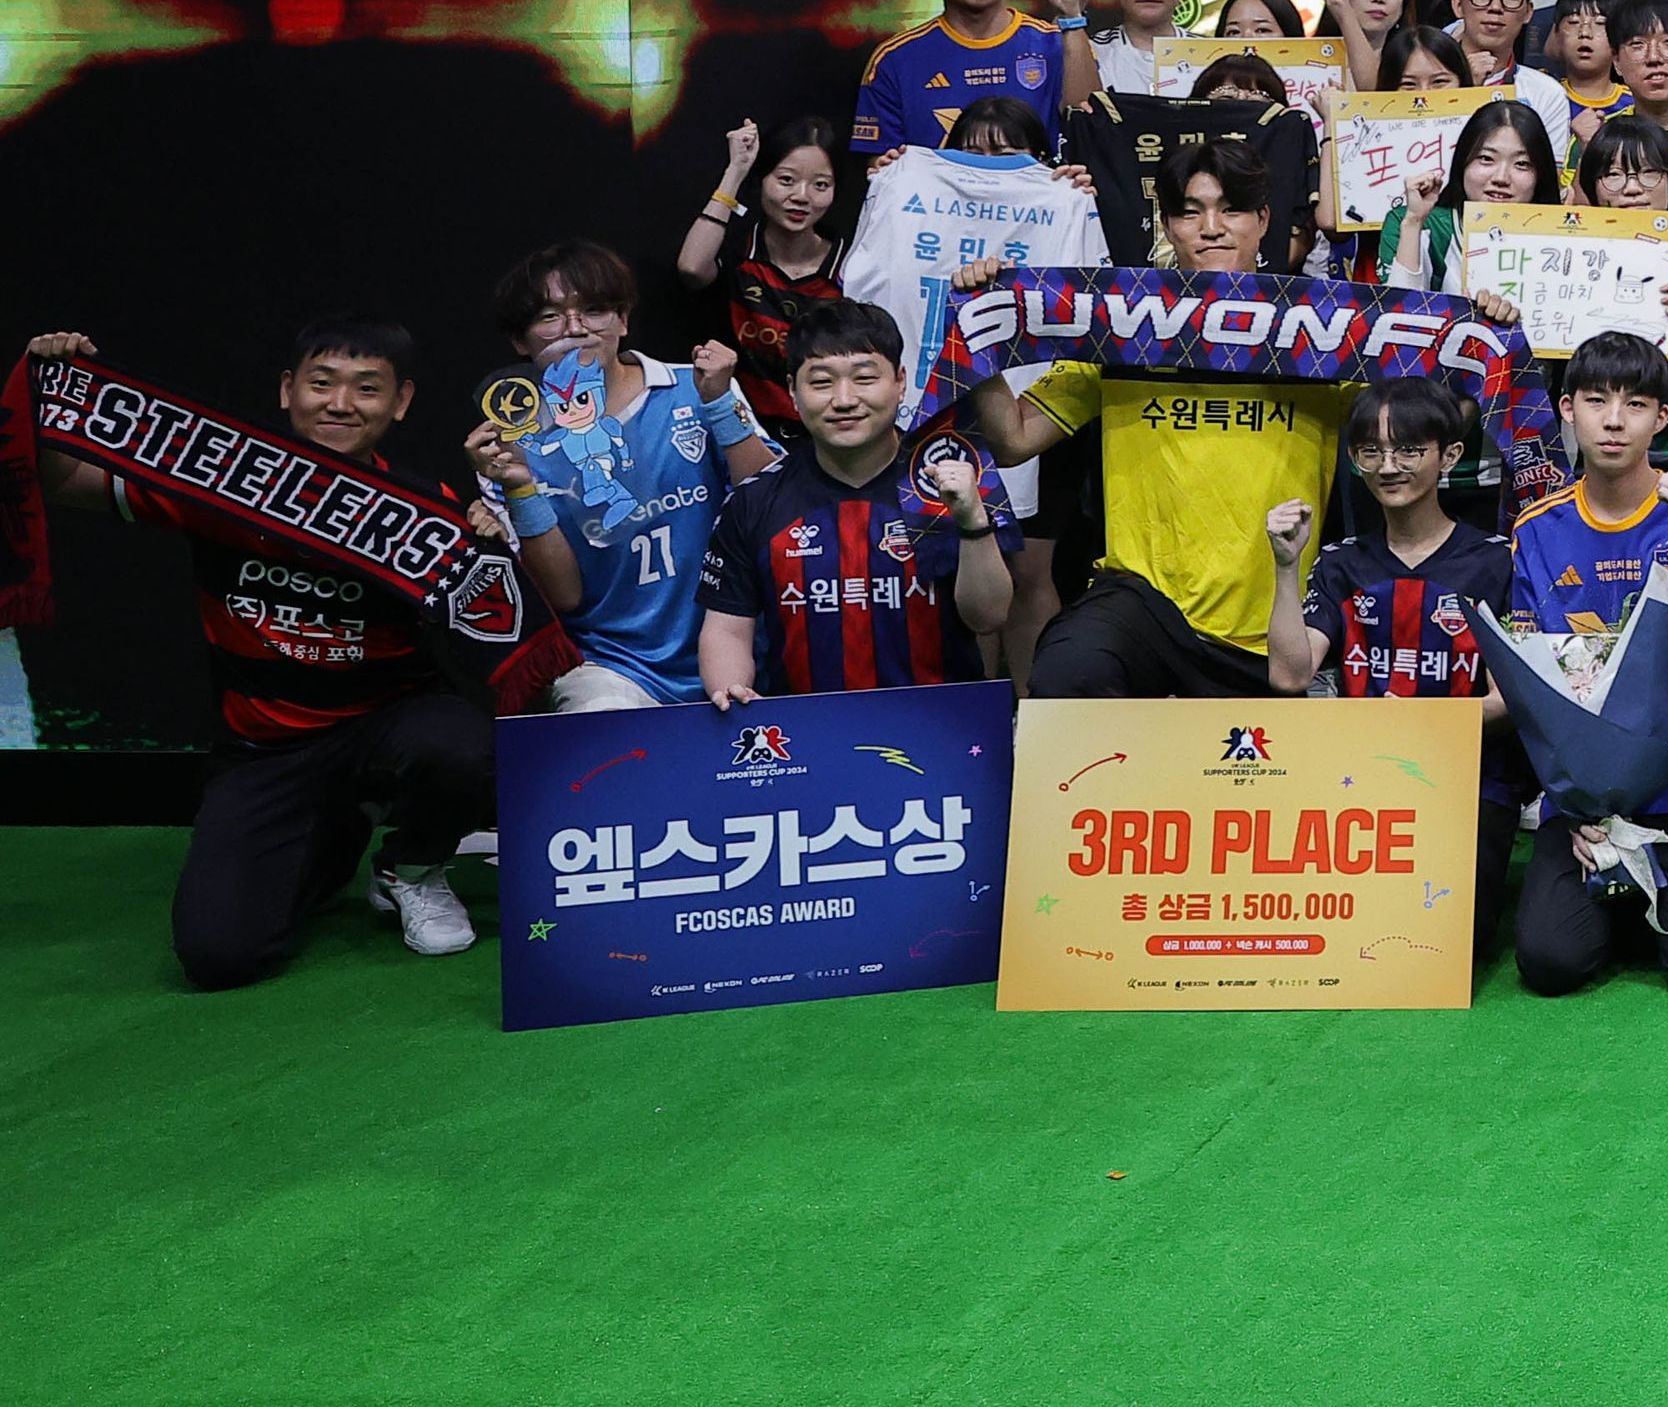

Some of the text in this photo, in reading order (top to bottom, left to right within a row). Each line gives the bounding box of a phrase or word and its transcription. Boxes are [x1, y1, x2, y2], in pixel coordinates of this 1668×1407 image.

[933, 198, 1057, 227] LASHEVAN
[956, 289, 1510, 383] SUWON FC
[1140, 397, 1296, 432] 수원특례시
[84, 382, 462, 580] STEELERS
[630, 524, 678, 588] 27
[238, 559, 365, 603] posco
[779, 576, 937, 616] 수원특례시
[1343, 644, 1480, 682] 수원특례시
[1066, 808, 1417, 877] 3RD PLACE
[674, 896, 856, 935] FCOSCAS AWARD
[1121, 893, 1355, 923] 총 상금 1,500,000
